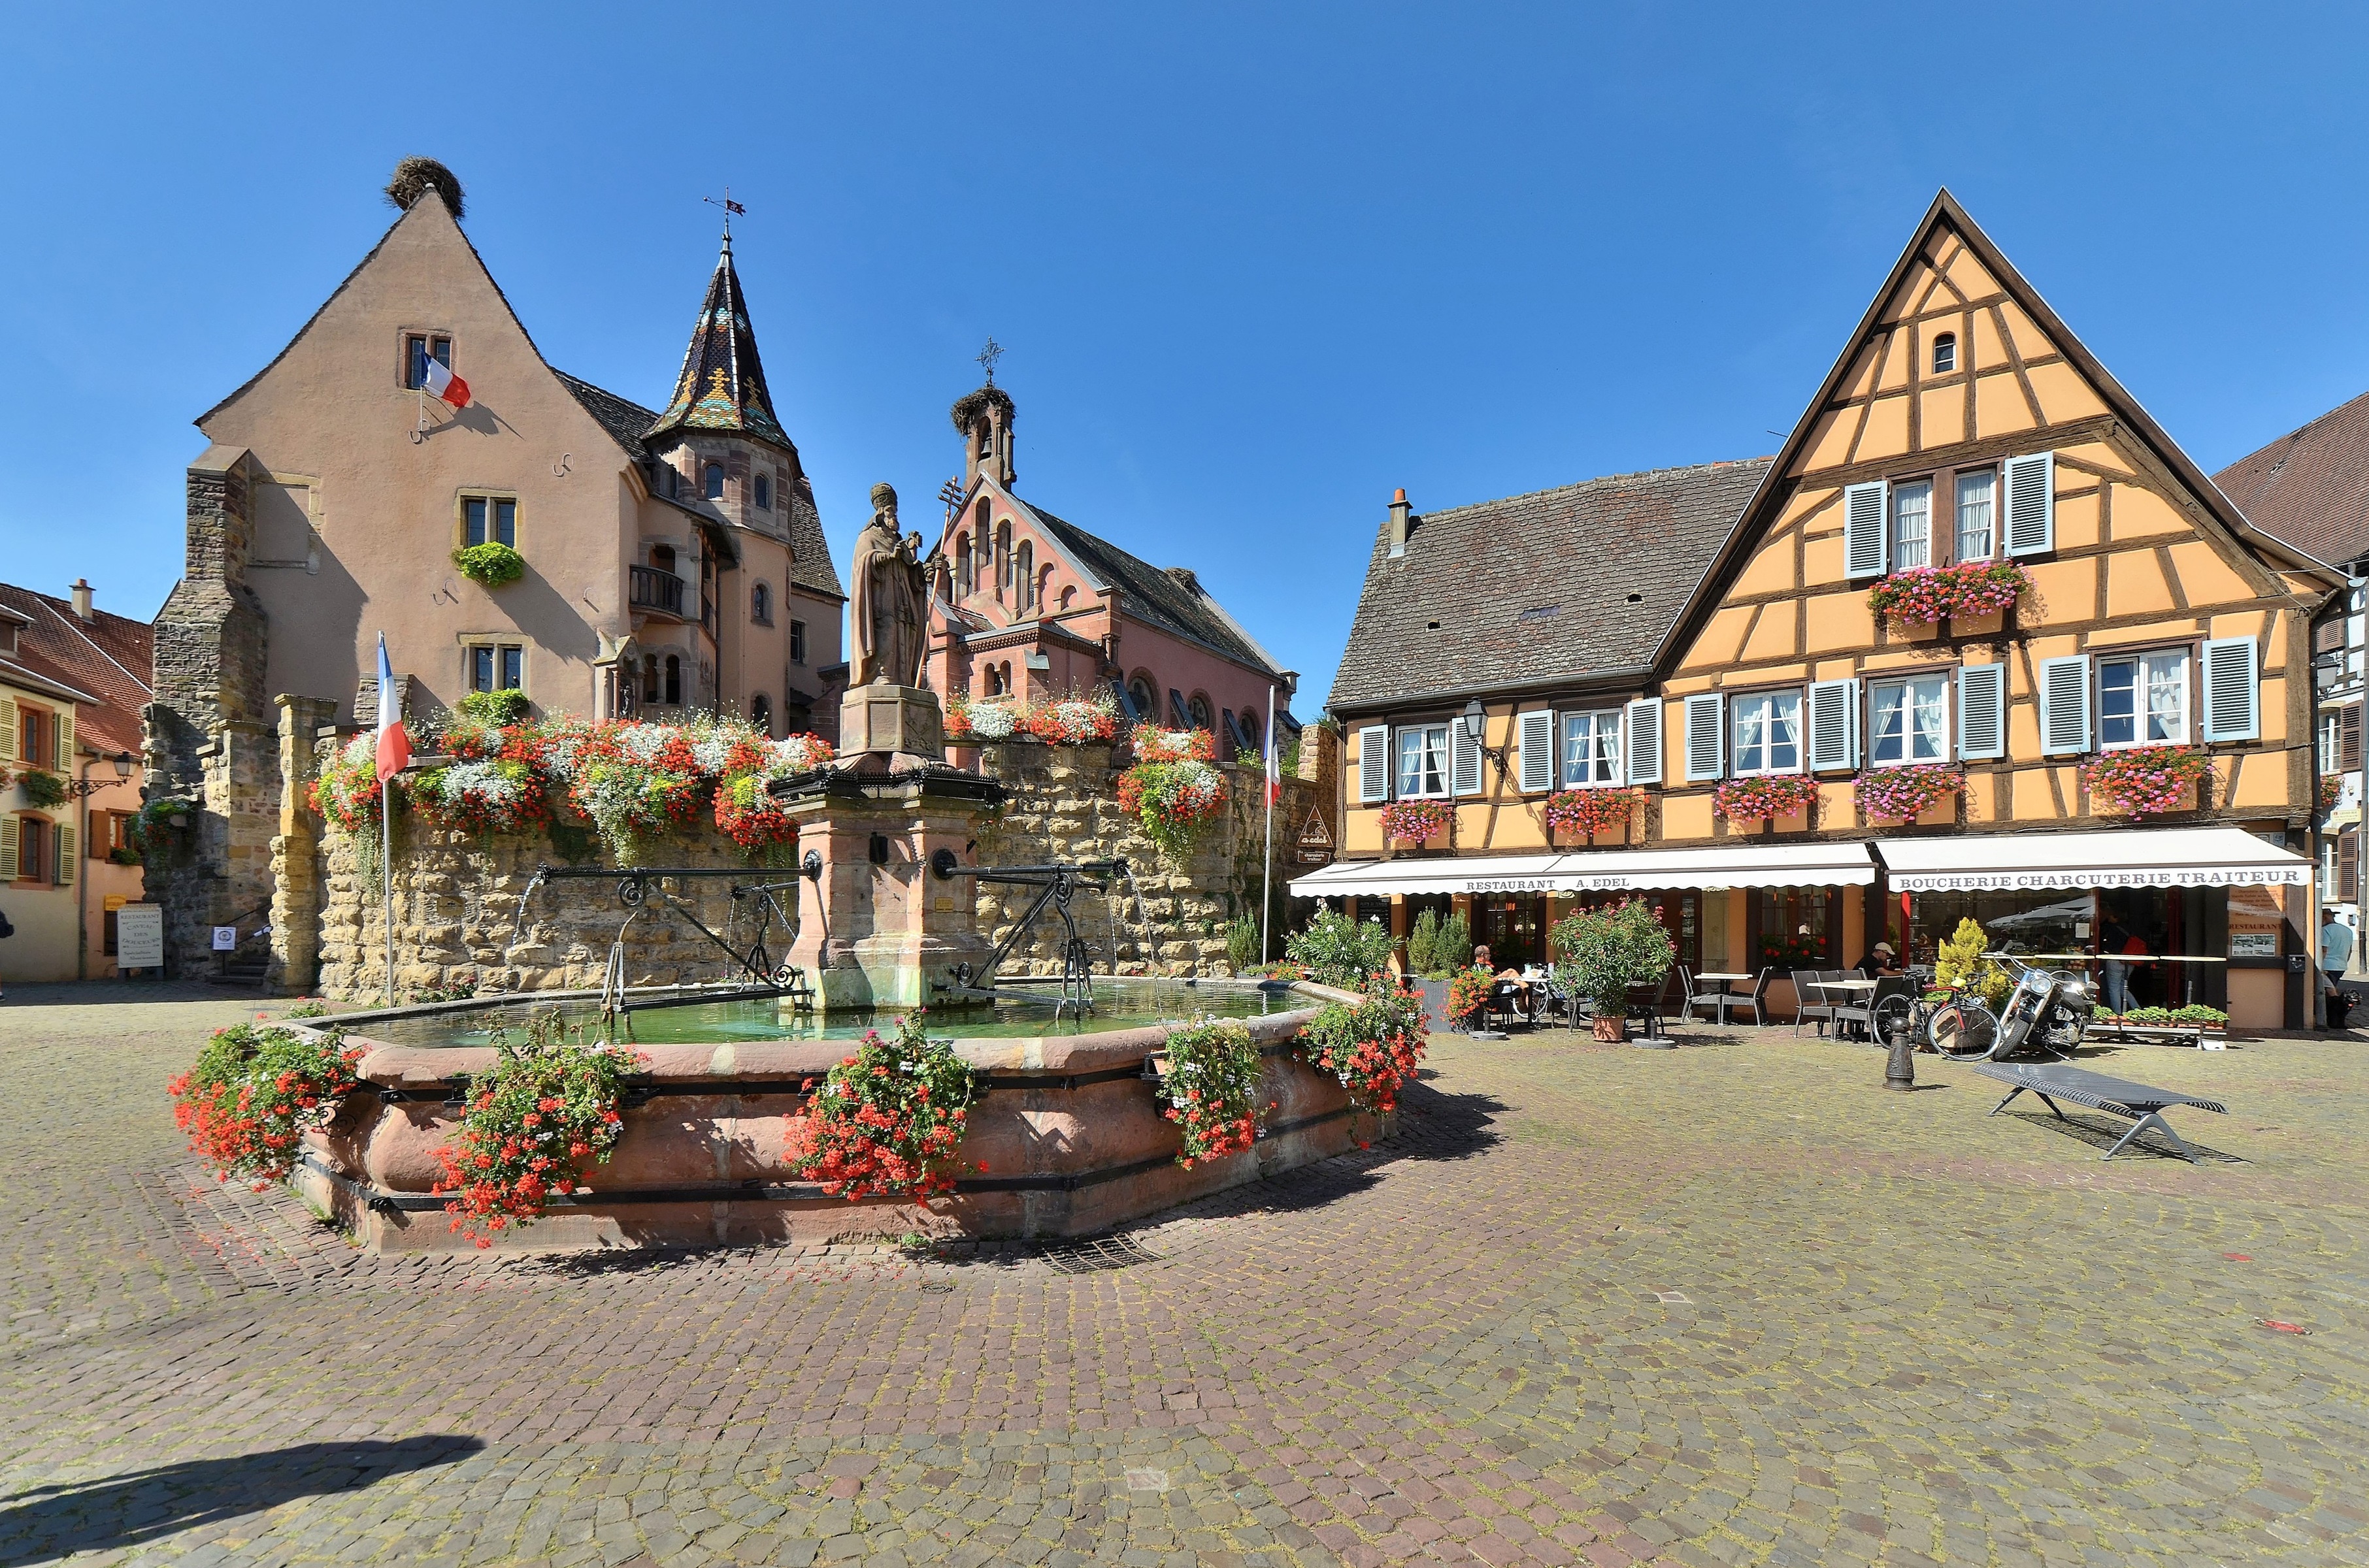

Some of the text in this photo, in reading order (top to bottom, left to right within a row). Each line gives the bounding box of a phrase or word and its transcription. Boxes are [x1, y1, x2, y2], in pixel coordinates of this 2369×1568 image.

[1309, 835, 1327, 843] edel
[1466, 878, 1630, 890] RESTAURANT A. EDEL
[1900, 871, 2300, 889] BOUCHERIE CHARCUTERIE TRAITEUR
